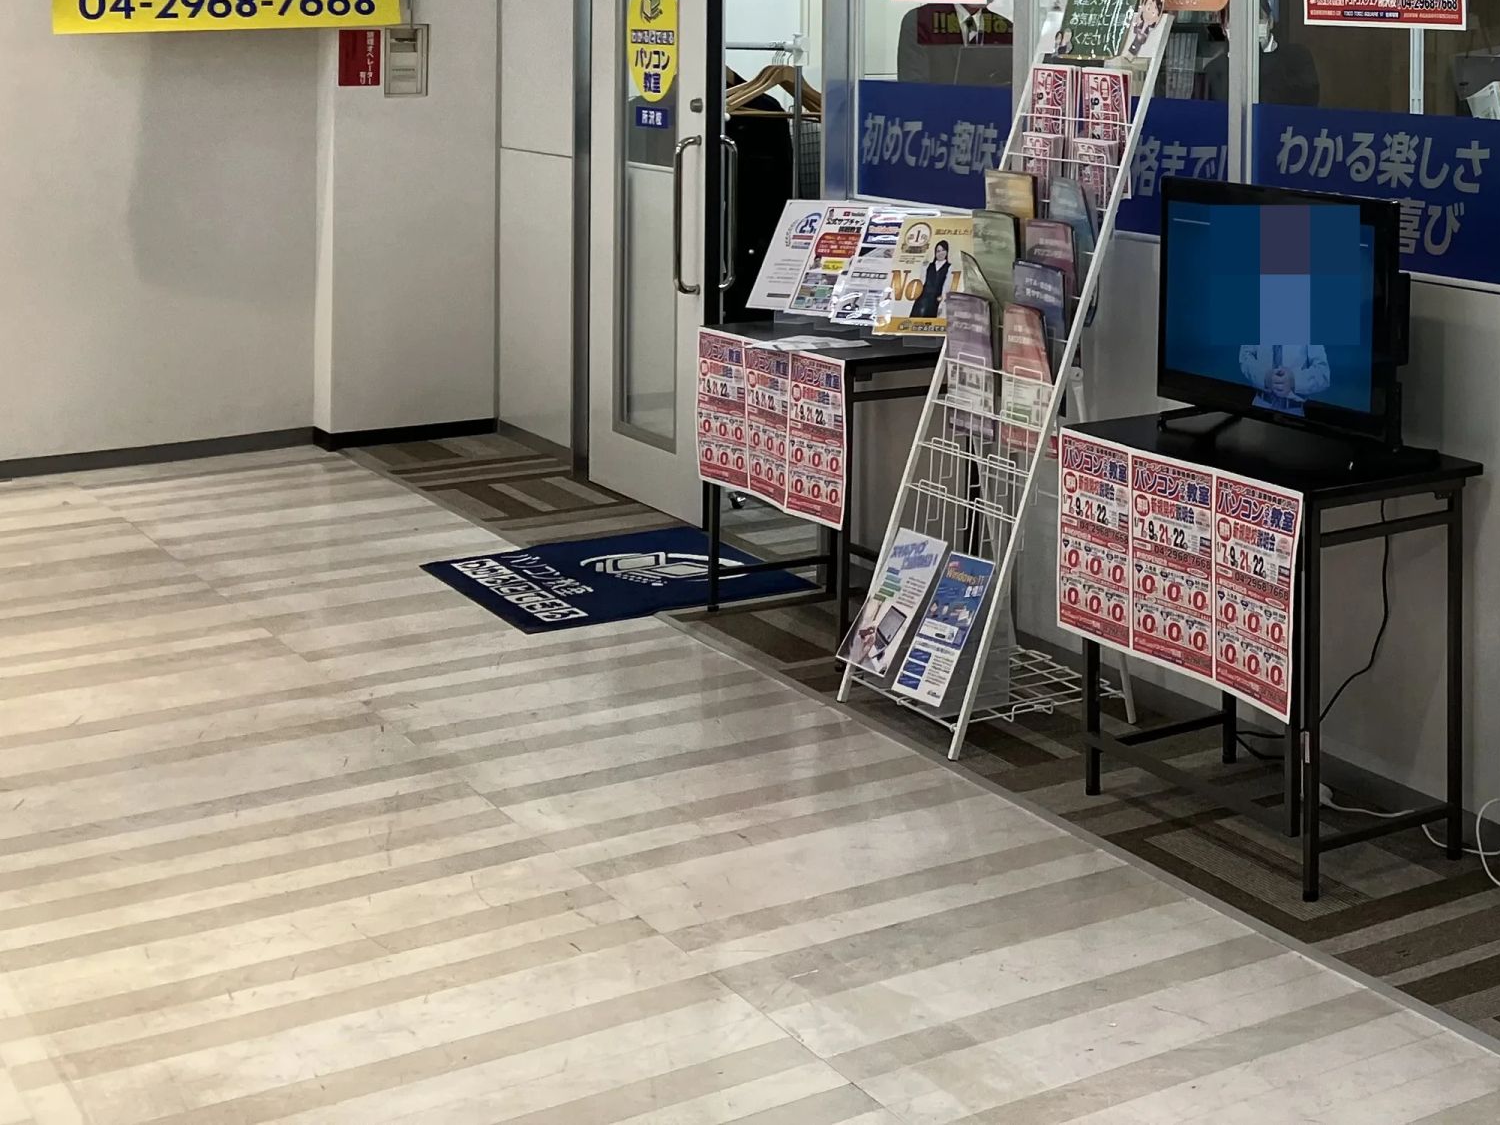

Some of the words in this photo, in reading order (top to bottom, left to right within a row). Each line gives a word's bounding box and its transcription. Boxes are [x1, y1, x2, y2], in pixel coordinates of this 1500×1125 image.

[634, 48, 670, 71] パソコン
[1275, 125, 1491, 194] わかる楽しさ
